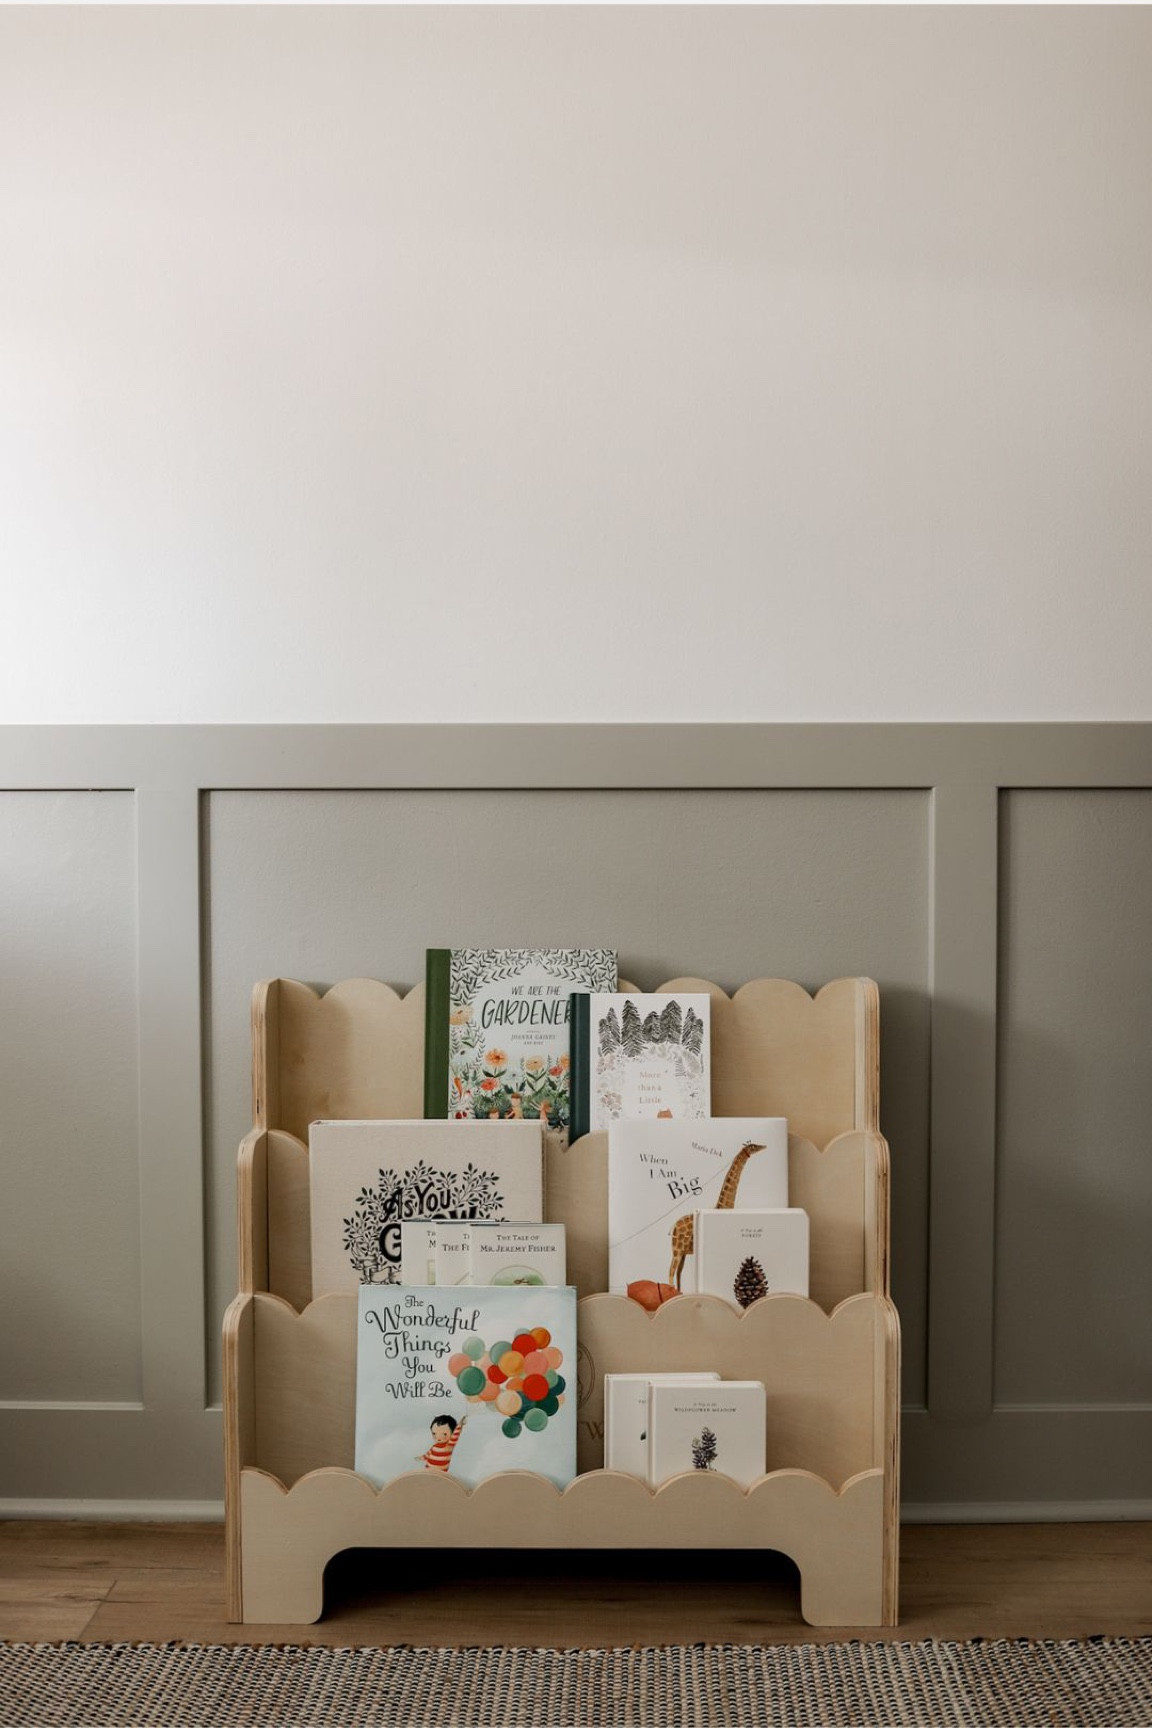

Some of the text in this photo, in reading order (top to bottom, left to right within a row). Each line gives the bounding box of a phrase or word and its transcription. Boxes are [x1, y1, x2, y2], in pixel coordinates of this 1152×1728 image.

[511, 985, 562, 996] WE ARE THE
[639, 1071, 662, 1079] More
[639, 1096, 662, 1104] Little
[639, 1153, 668, 1165] When
[658, 1168, 677, 1179] Am
[667, 1176, 703, 1200] Big
[442, 1243, 459, 1252] THE
[495, 1244, 527, 1253] JEREMY
[528, 1244, 556, 1253] FISHER
[404, 1294, 425, 1308] The
[365, 1303, 481, 1335] Wonderful
[383, 1330, 452, 1360] Things
[402, 1355, 436, 1379] You
[385, 1380, 453, 1400] Will Be
